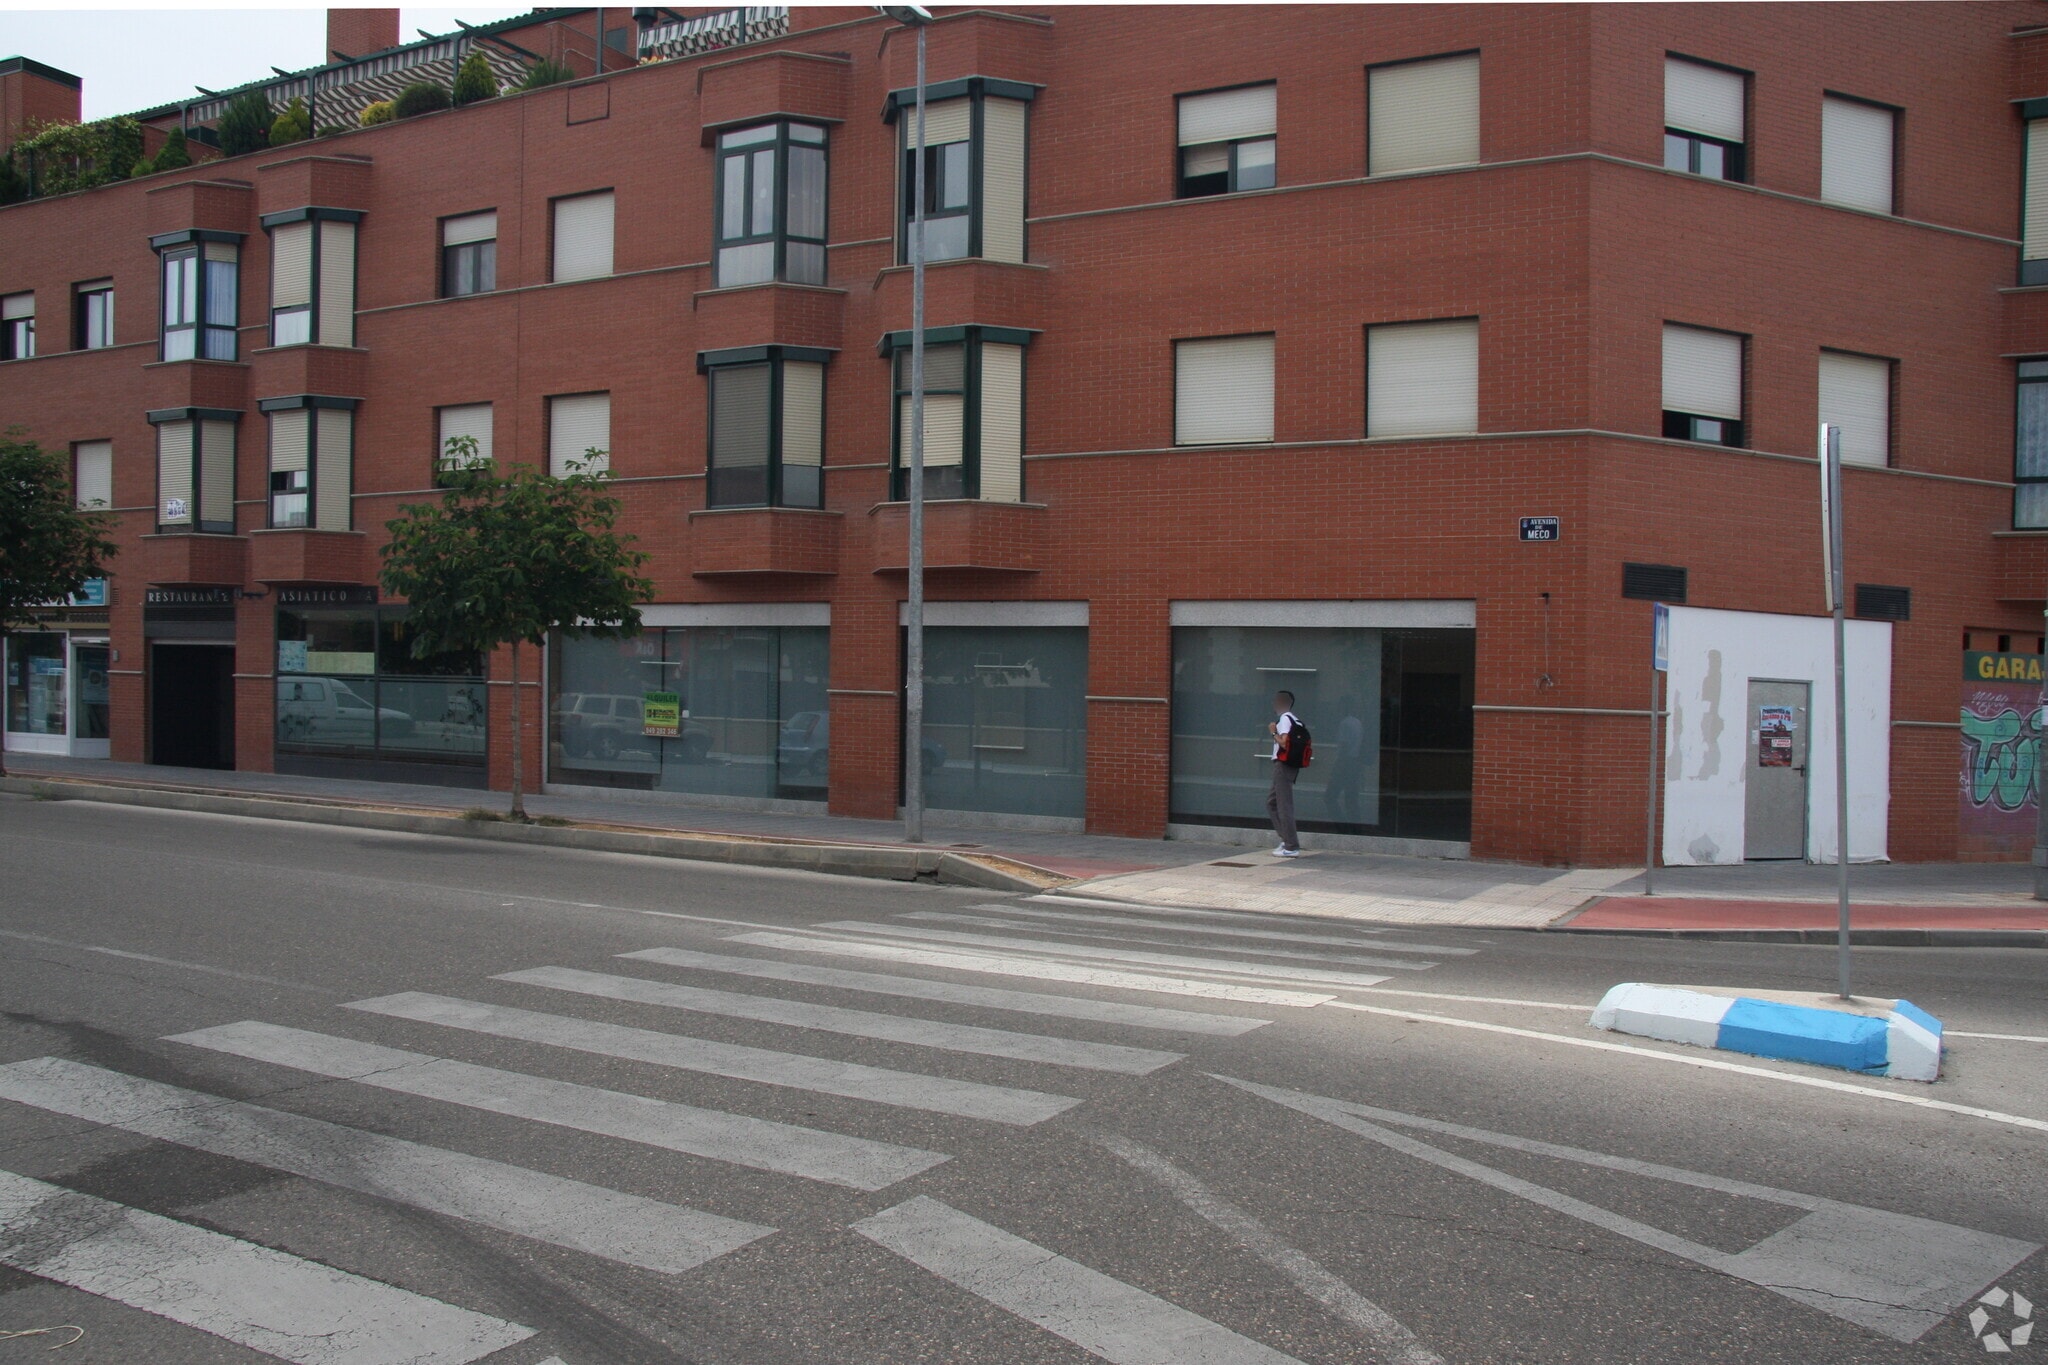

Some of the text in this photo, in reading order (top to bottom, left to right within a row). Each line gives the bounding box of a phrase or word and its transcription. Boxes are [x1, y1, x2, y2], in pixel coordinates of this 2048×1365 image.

[1528, 530, 1550, 539] MECO
[281, 591, 347, 602] ASIATICO
[1978, 655, 2045, 680] GARA
[646, 694, 678, 703] ALQUILER
